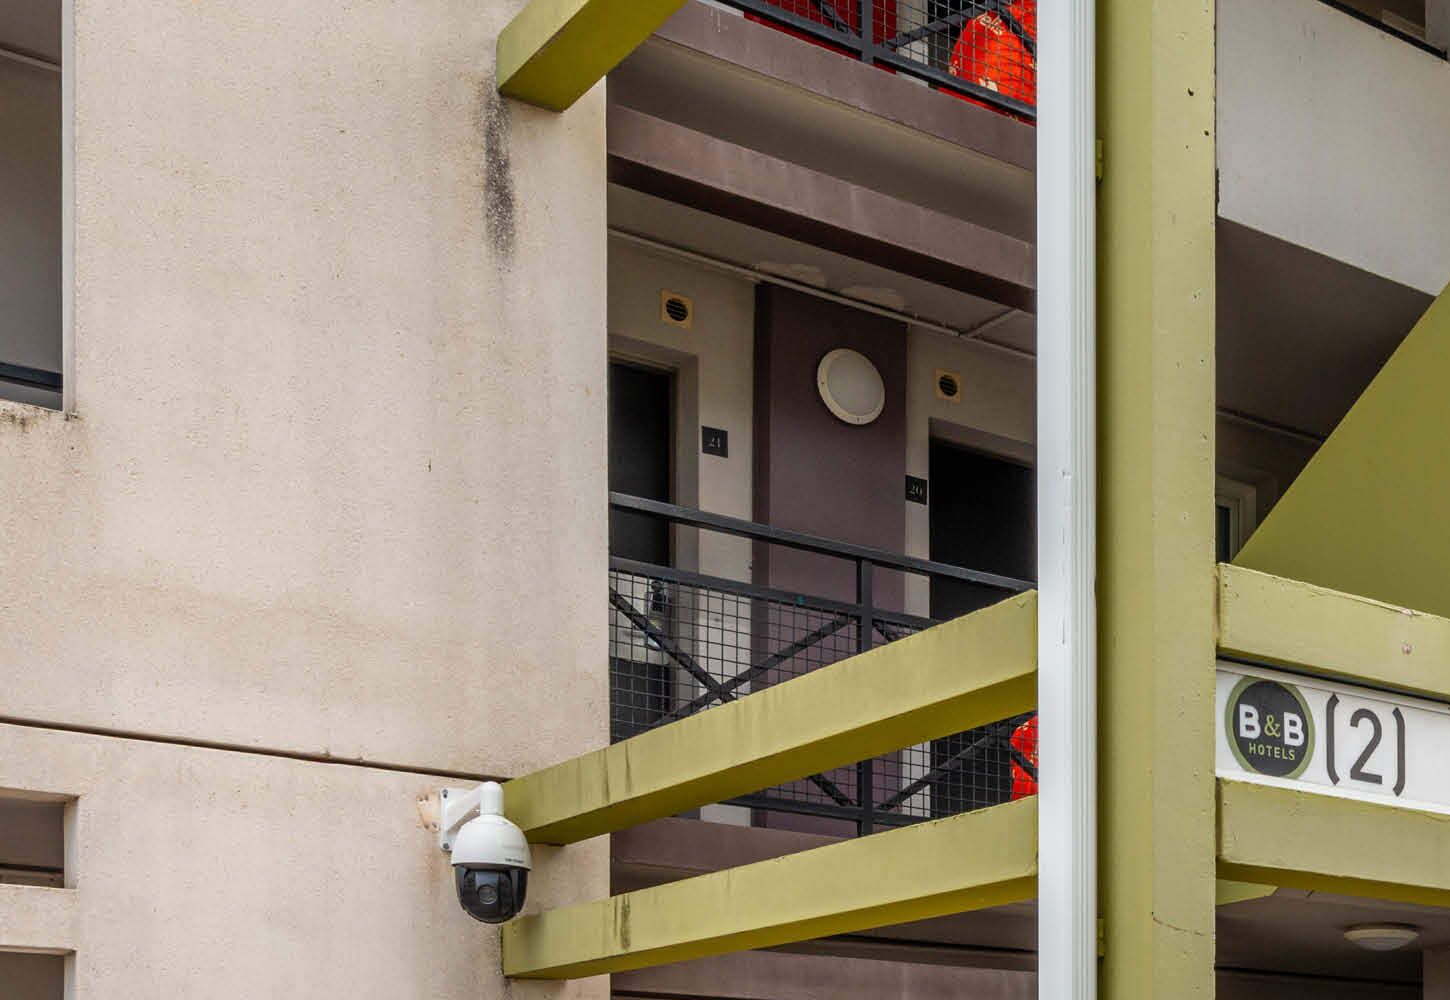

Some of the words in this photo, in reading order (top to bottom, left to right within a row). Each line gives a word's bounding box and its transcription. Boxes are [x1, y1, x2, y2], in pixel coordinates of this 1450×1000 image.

[1239, 703, 1305, 747] B&B
[1326, 692, 1406, 797] (2)
[1249, 742, 1296, 761] HOTELS
